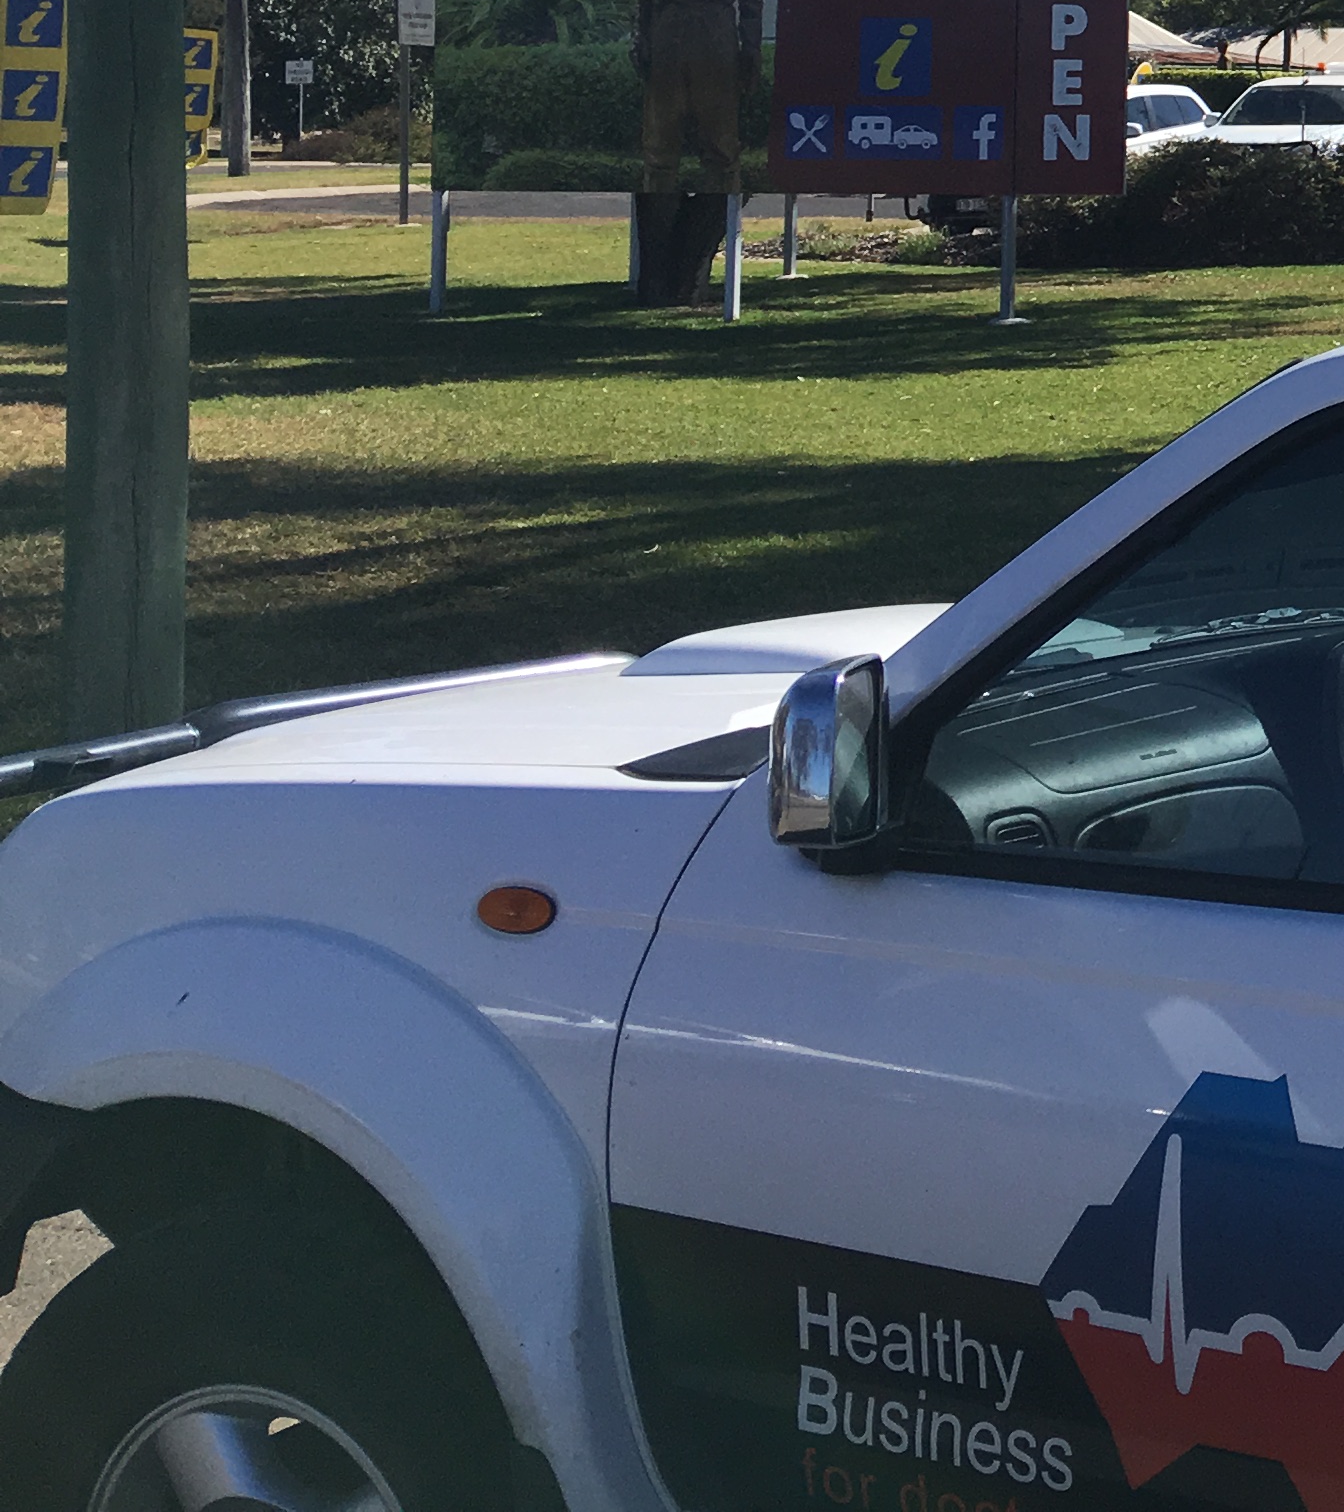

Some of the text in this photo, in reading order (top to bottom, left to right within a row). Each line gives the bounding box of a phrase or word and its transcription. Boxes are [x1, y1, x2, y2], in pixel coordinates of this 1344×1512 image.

[798, 1286, 1024, 1411] Healthy
[797, 1364, 1073, 1492] Business
[802, 1447, 876, 1509] for
